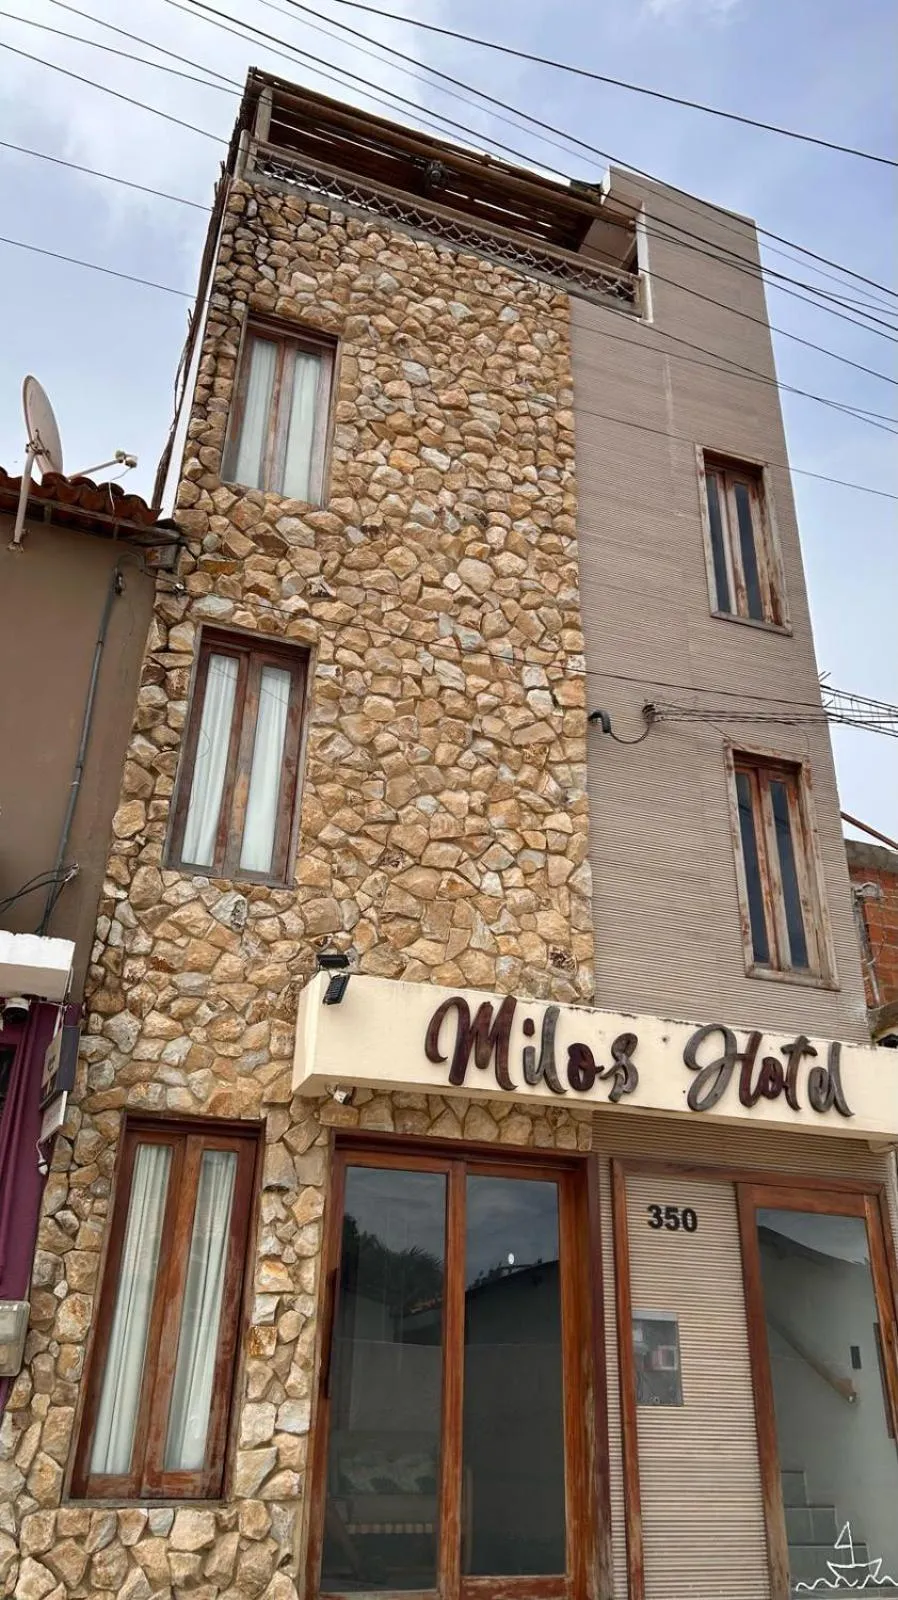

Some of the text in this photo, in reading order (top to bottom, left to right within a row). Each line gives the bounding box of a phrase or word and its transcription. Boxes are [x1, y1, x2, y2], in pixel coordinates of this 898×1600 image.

[426, 995, 855, 1117] Milos Hotel
[648, 1205, 698, 1232] 350
